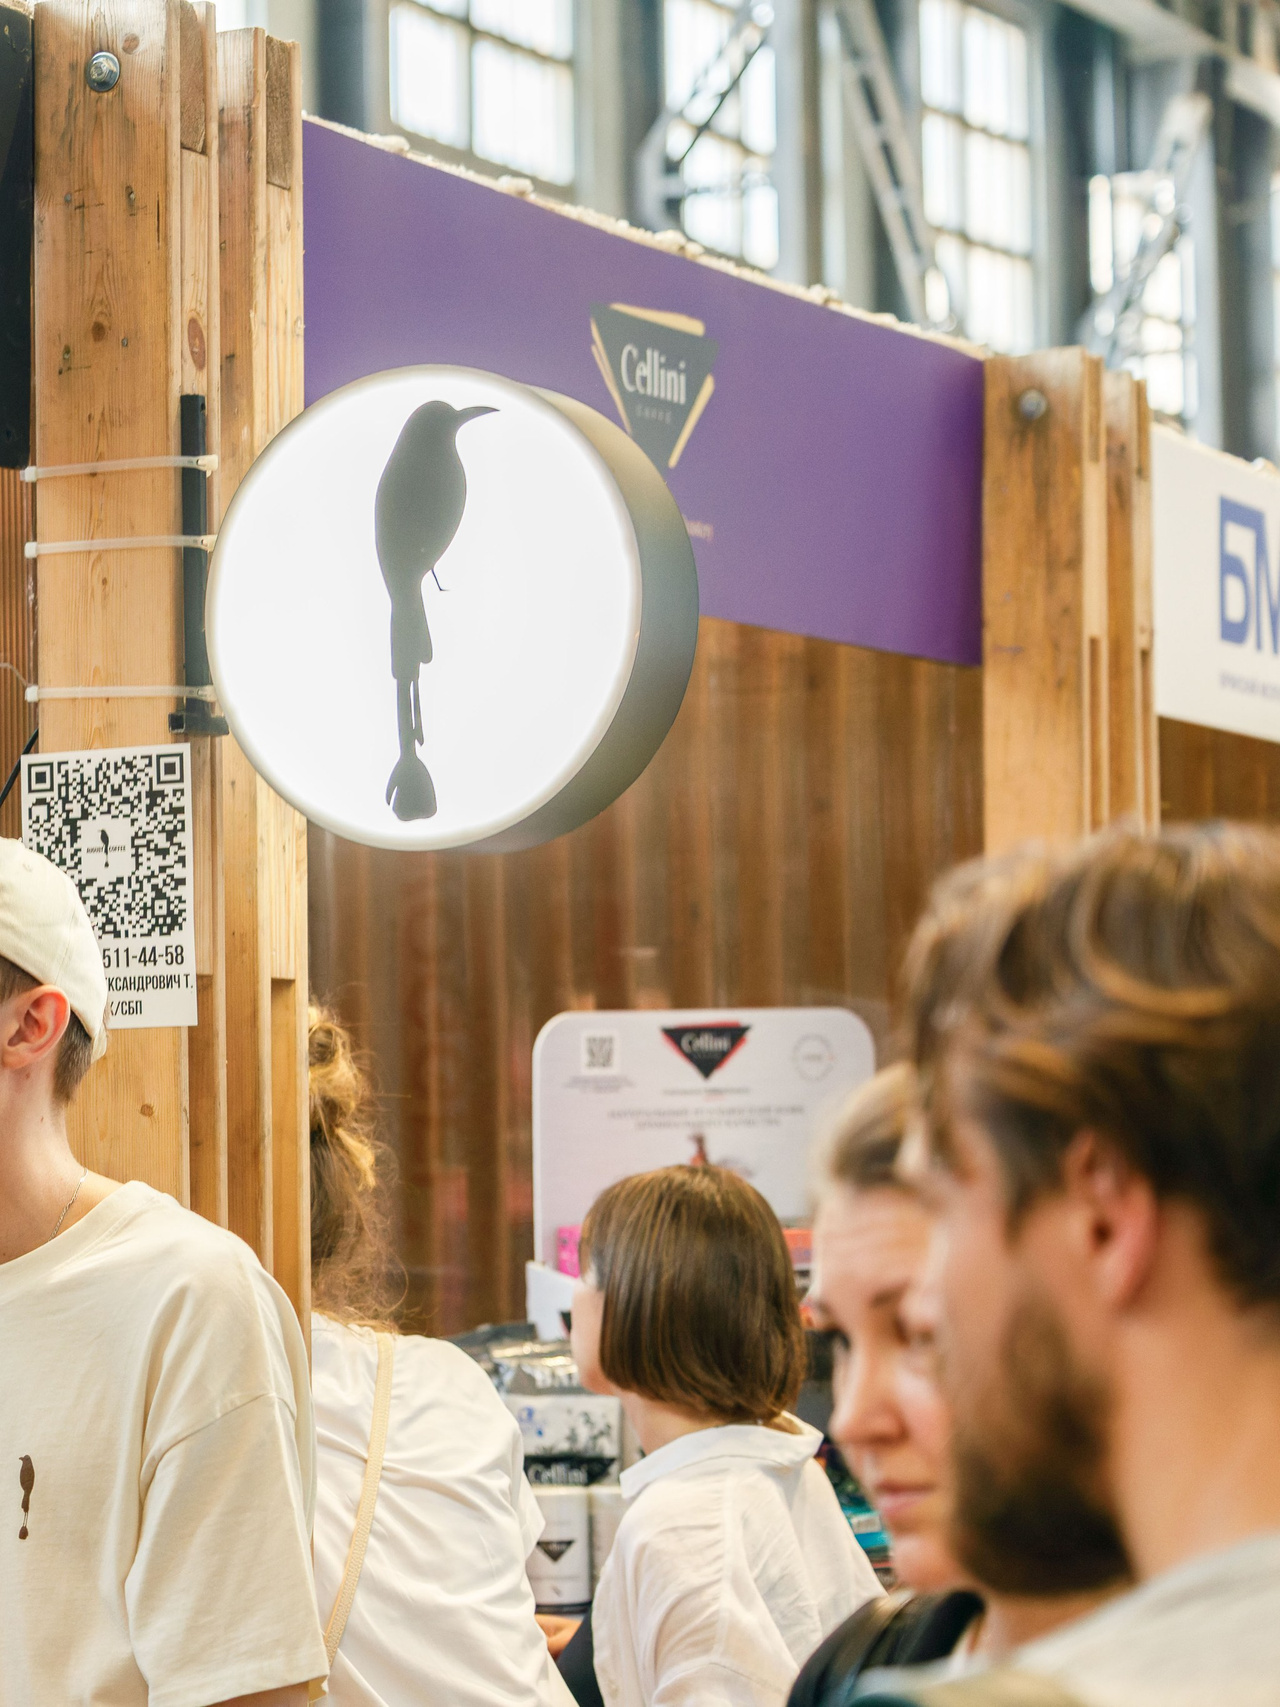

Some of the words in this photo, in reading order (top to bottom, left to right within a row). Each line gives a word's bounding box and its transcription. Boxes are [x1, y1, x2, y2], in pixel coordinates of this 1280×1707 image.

[620, 342, 687, 406] Cellini
[105, 974, 181, 993] КСАНДРОВИЧ
[183, 973, 193, 989] Т.
